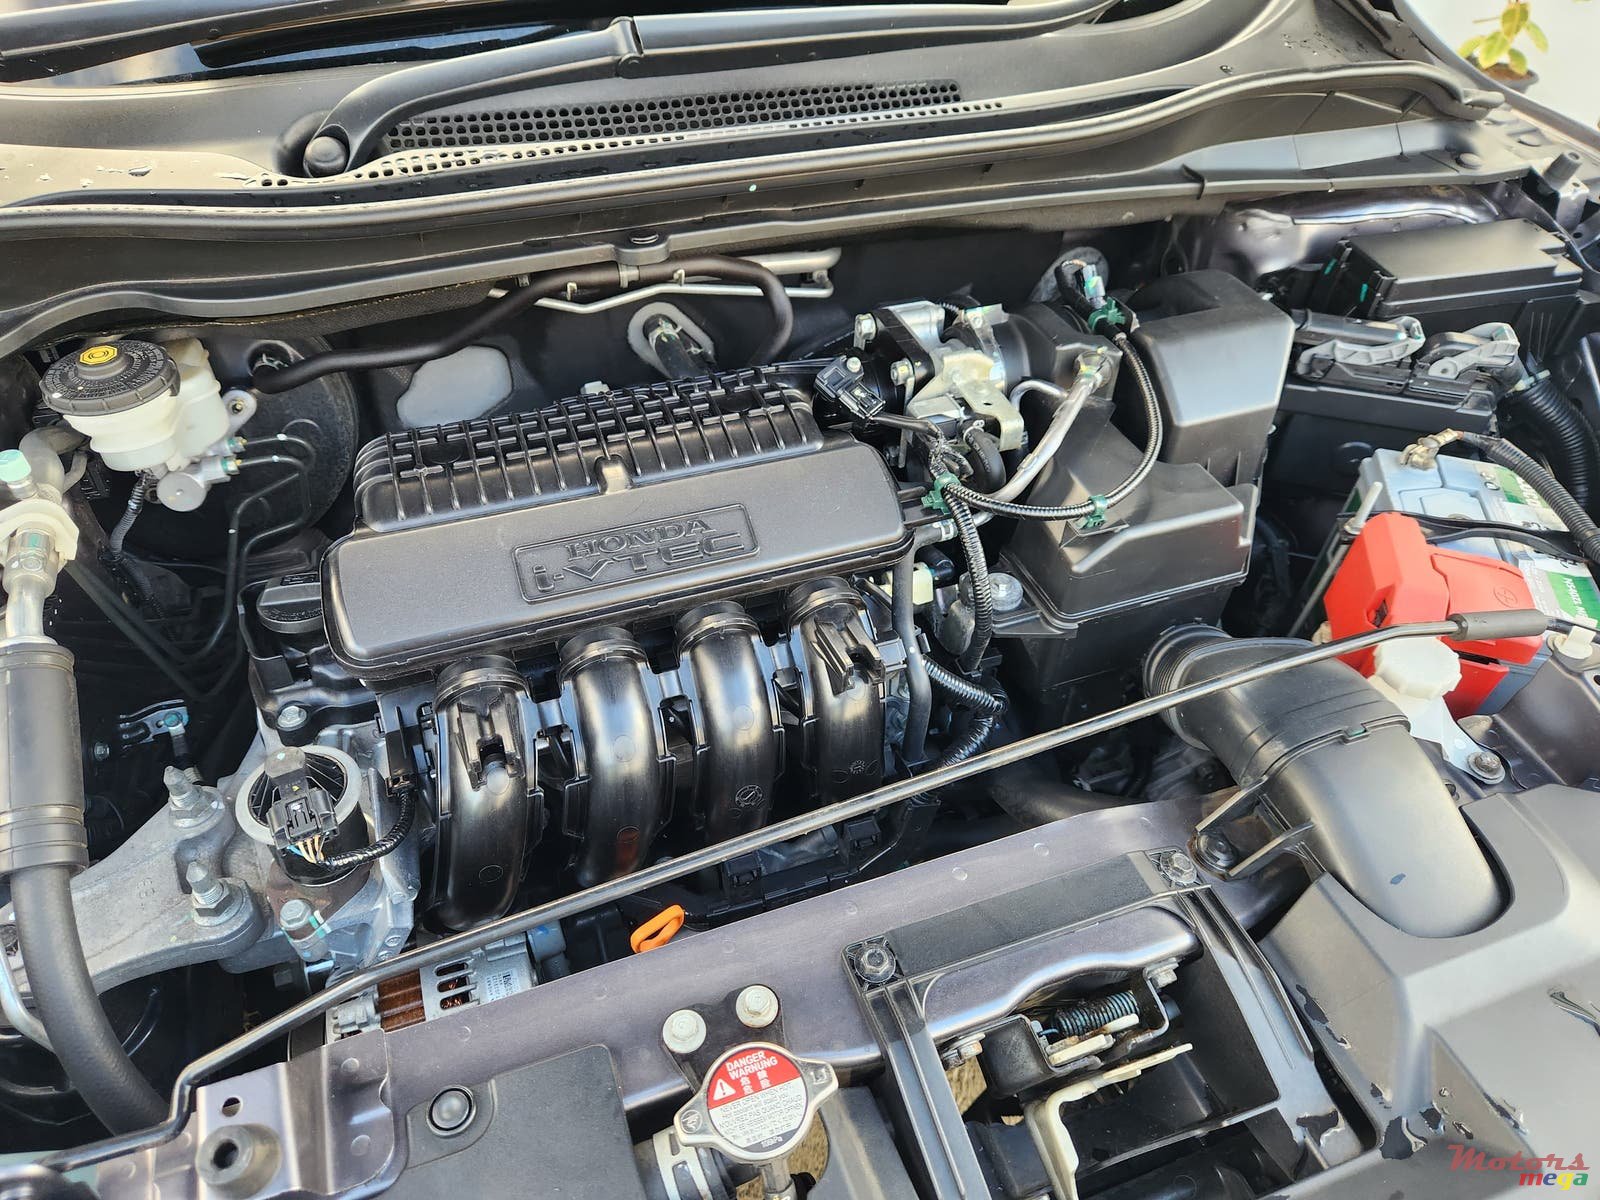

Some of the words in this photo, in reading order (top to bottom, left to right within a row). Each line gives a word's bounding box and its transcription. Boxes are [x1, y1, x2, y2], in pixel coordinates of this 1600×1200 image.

[565, 518, 716, 561] HONDA
[532, 532, 745, 592] i-VTEC
[725, 1051, 765, 1071] DANGER
[728, 1057, 778, 1080] WARNUNG
